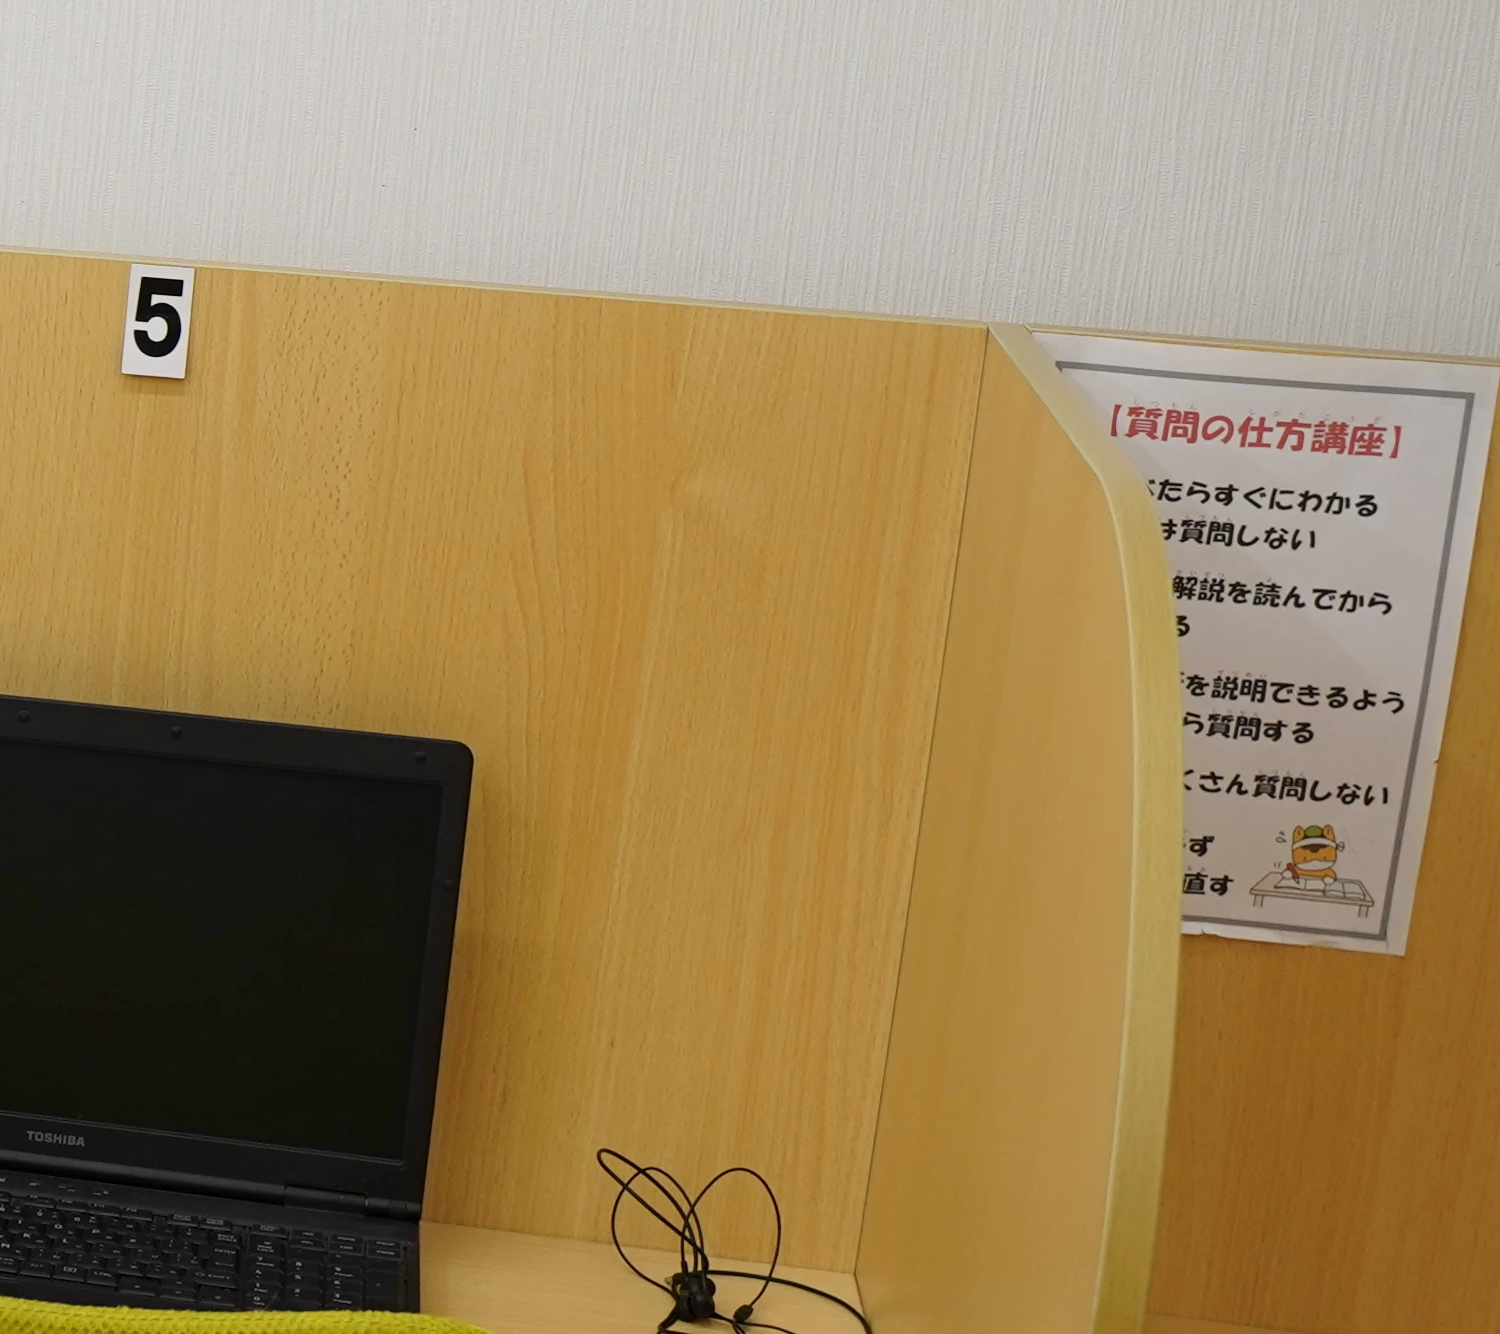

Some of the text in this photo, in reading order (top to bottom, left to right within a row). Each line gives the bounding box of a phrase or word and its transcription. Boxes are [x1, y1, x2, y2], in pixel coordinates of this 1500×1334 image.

[133, 276, 184, 358] 5
[1181, 672, 1406, 715] を説明できるよう
[26, 1129, 86, 1148] TOSHIBA
